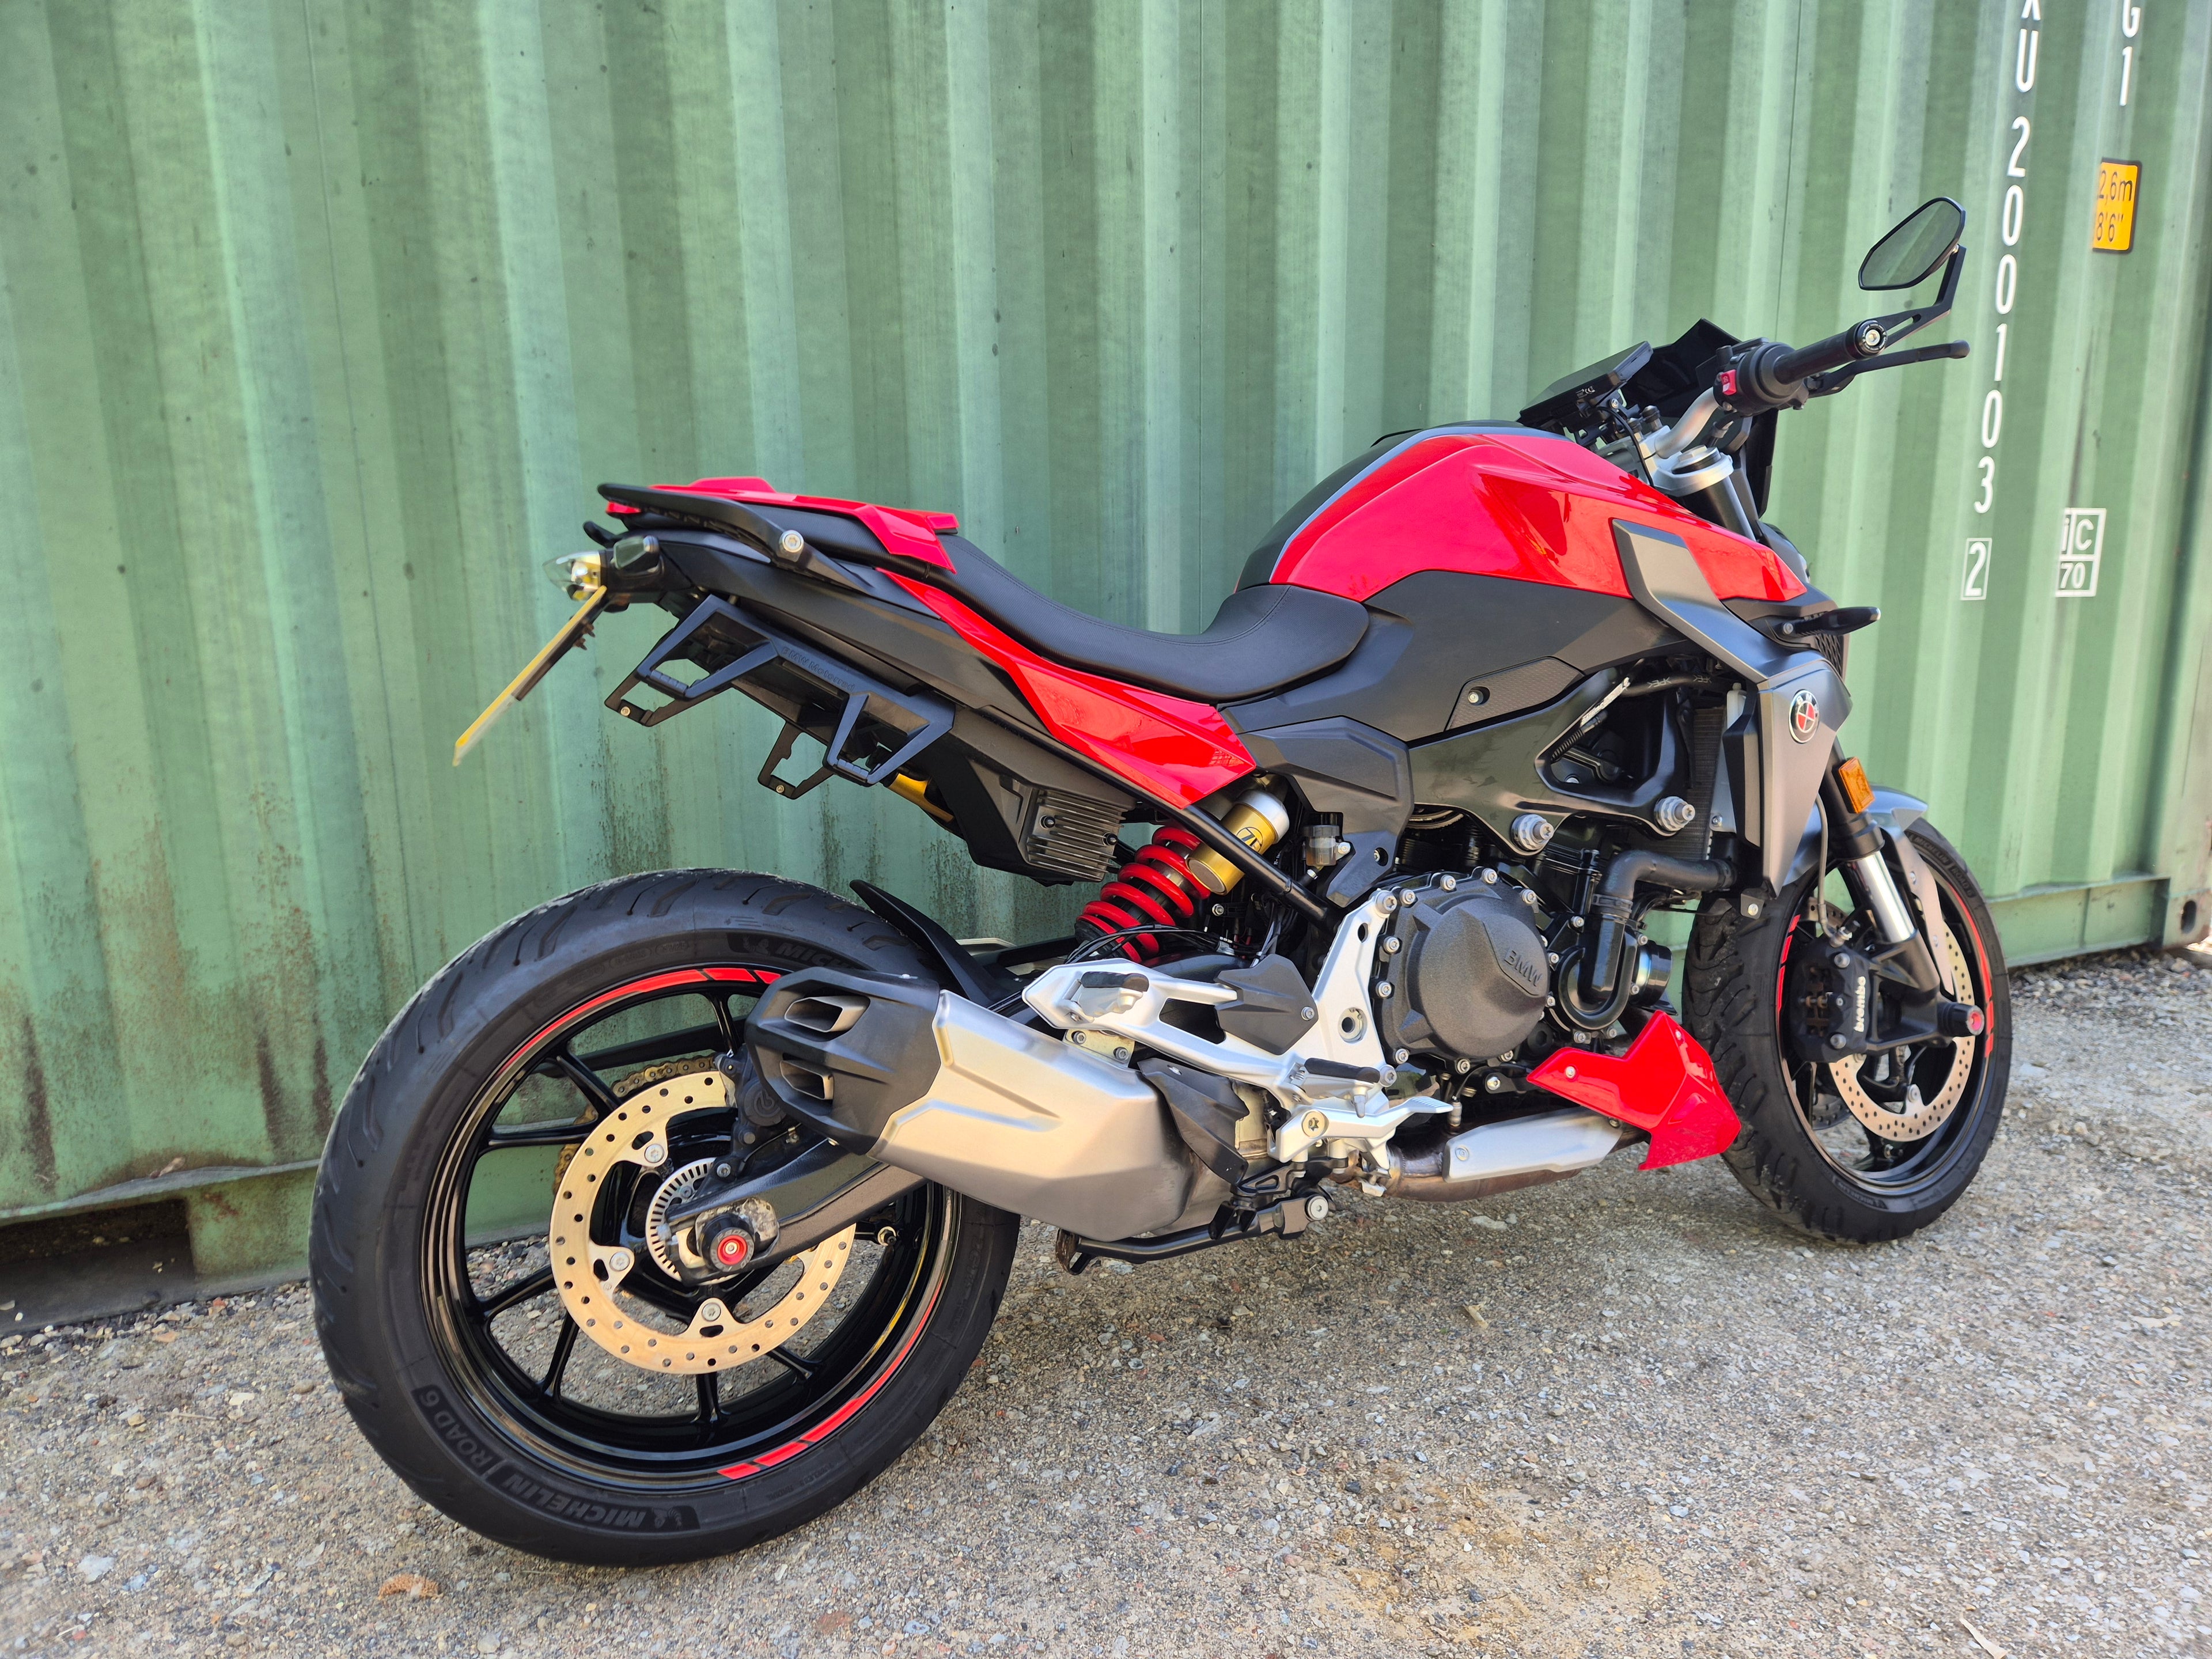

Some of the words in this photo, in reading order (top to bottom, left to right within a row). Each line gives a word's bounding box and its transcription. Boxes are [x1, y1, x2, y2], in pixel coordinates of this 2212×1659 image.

[2060, 562, 2086, 589] 70
[782, 646, 809, 666] BMW
[808, 661, 855, 692] Motorrad
[1503, 950, 1543, 987] BMW
[434, 1411, 494, 1468] ROAD
[501, 1473, 646, 1528] MICHELIN
